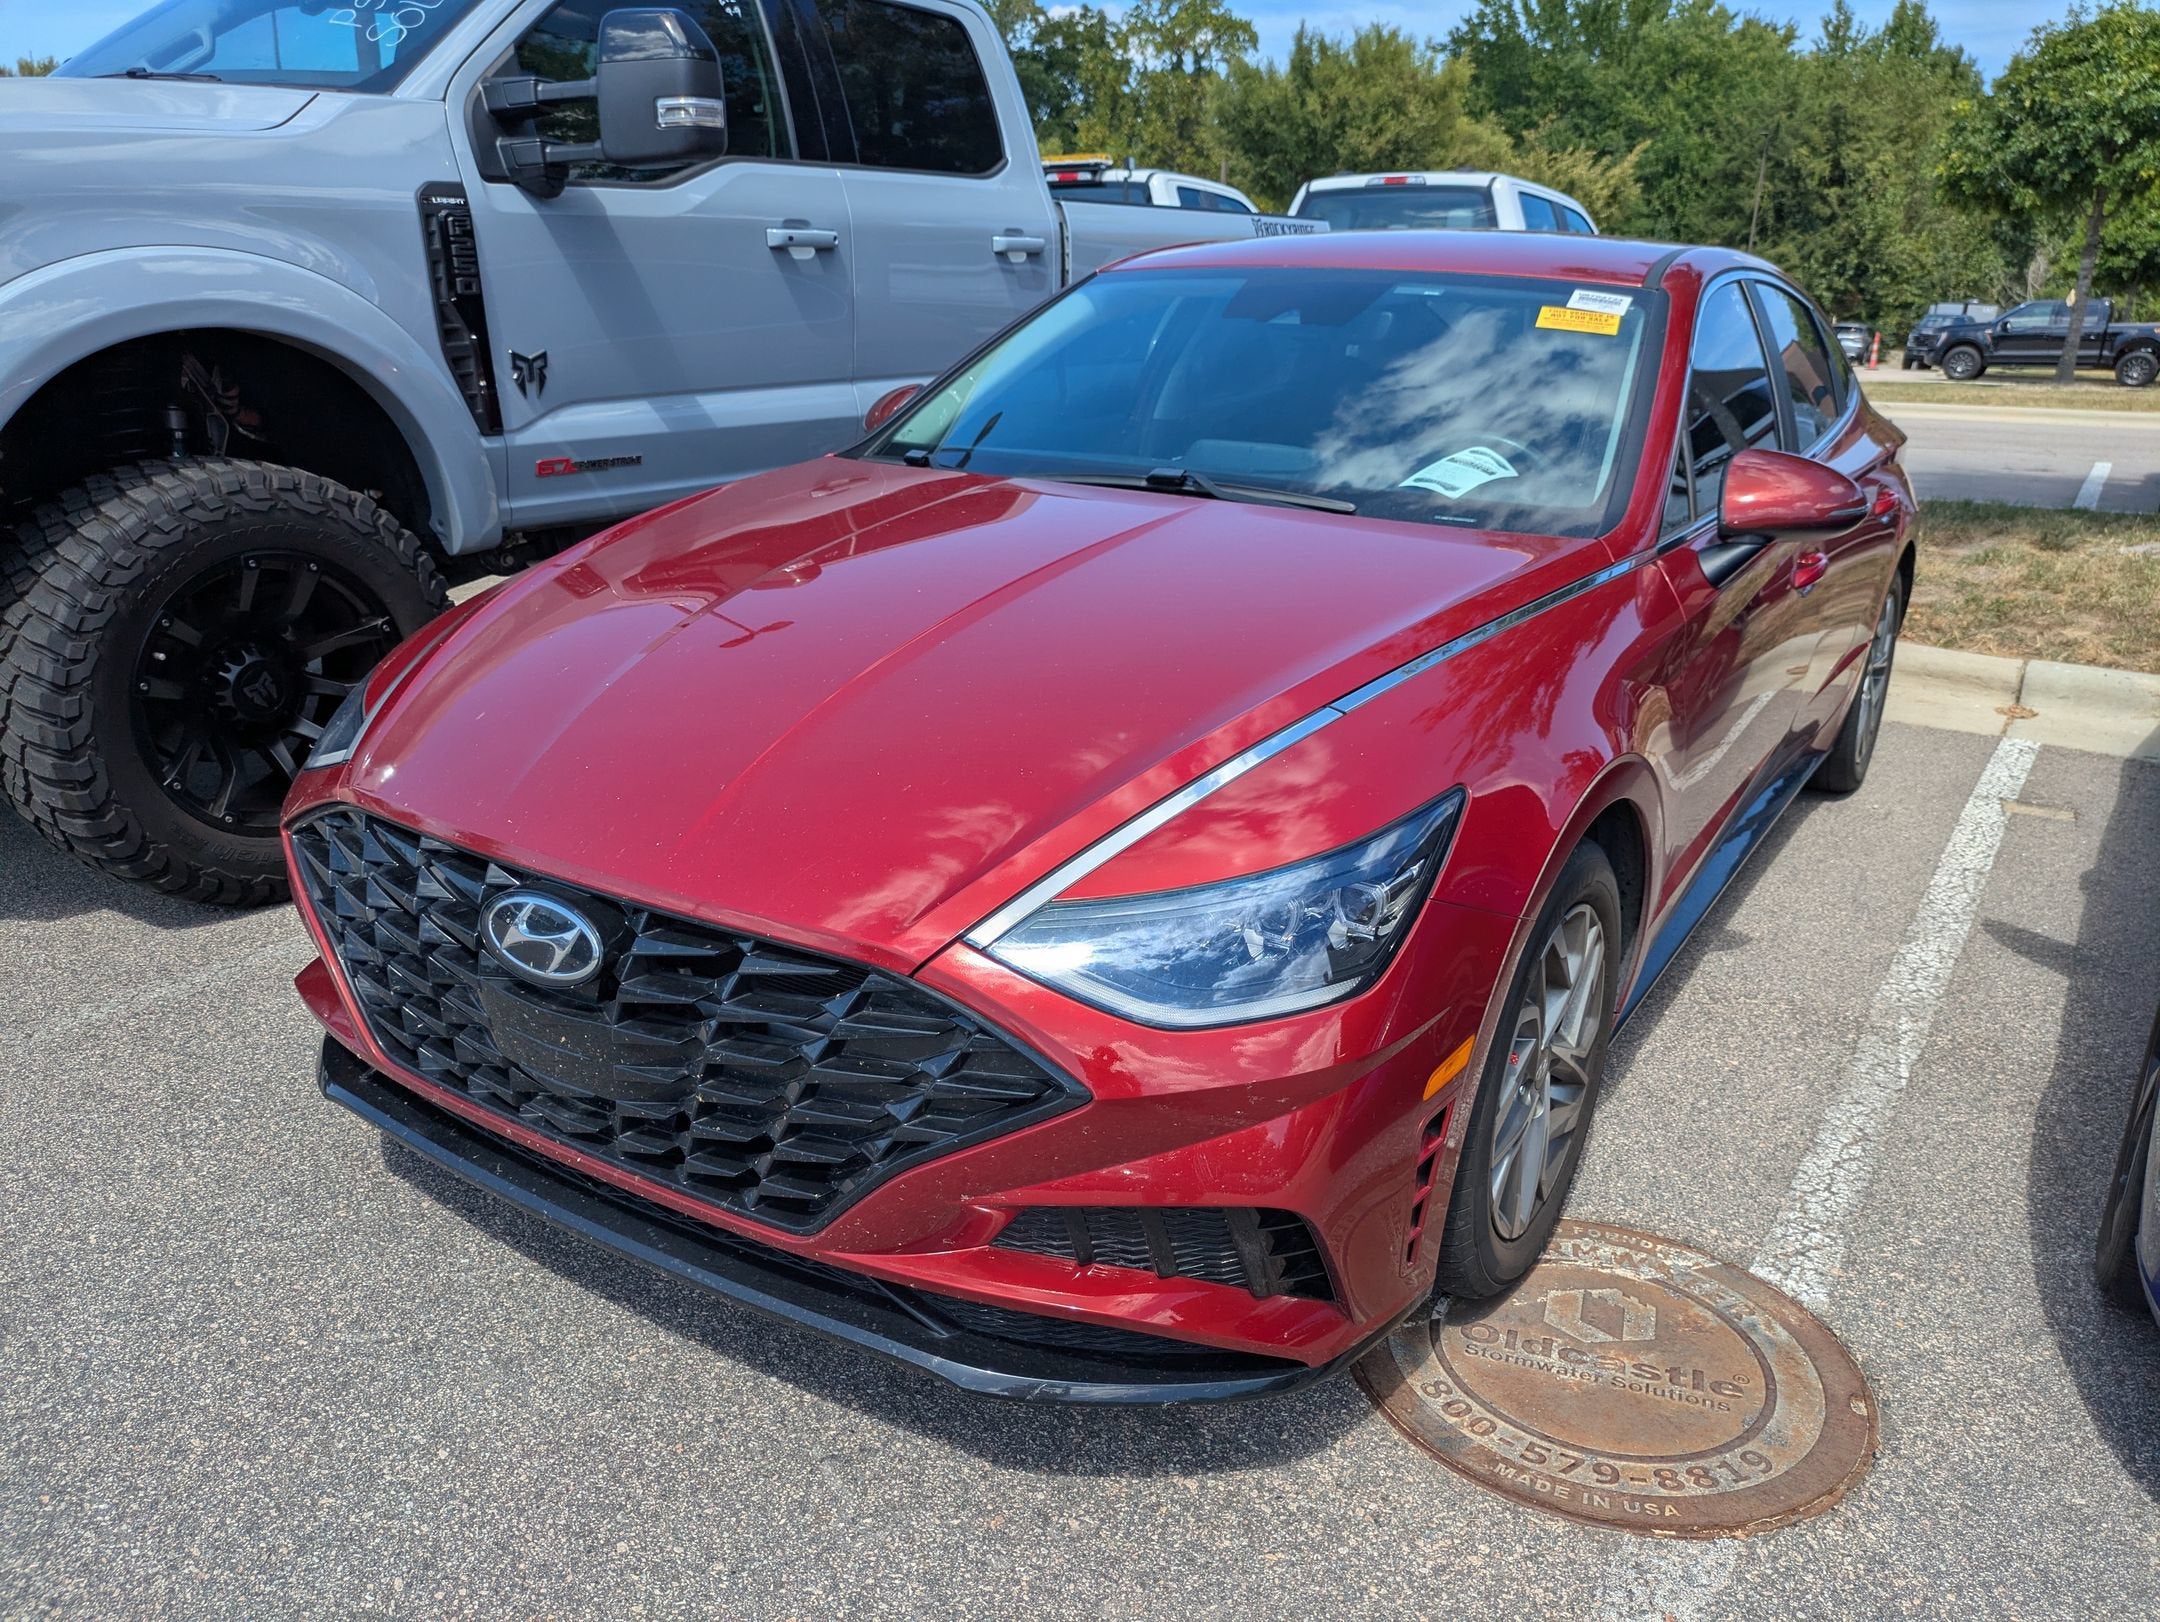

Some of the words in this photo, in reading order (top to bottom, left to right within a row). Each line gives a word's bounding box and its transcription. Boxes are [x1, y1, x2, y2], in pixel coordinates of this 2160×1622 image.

[610, 455, 642, 468] STROKE
[1464, 1343, 1600, 1384] Stormwater
[1610, 1375, 1731, 1412] Solutions
[1420, 1379, 1774, 1493] 800-579-8819
[1495, 1462, 1570, 1500] MADE
[1582, 1492, 1612, 1510] IN
[1624, 1501, 1683, 1518] USA
